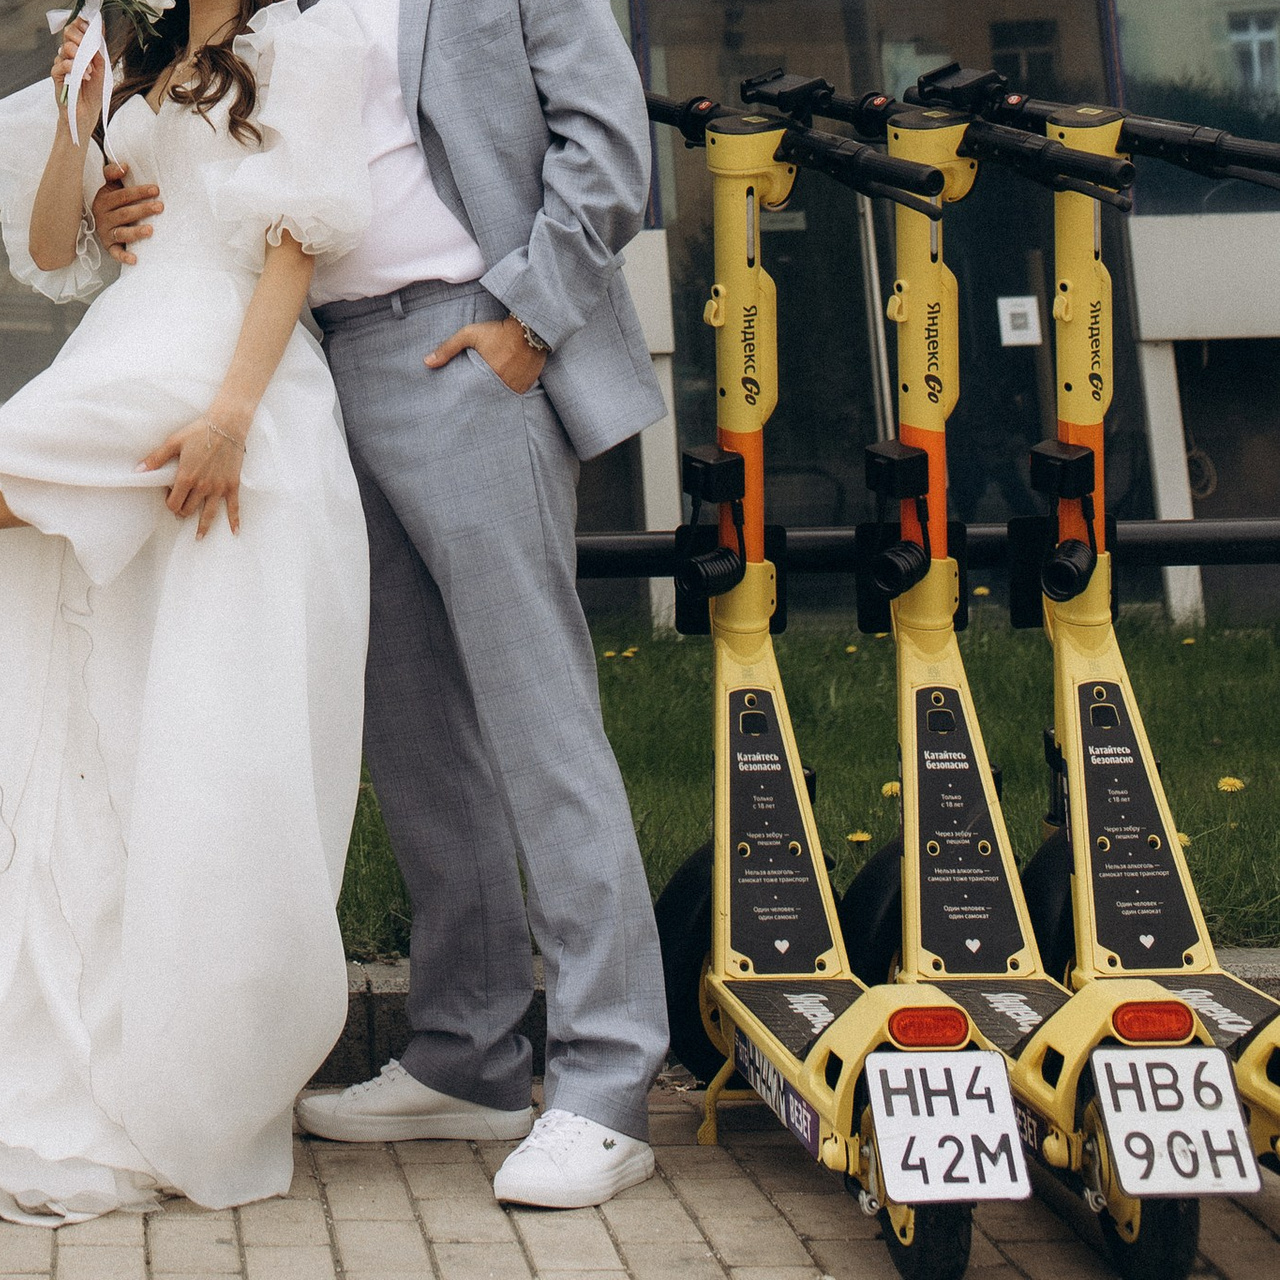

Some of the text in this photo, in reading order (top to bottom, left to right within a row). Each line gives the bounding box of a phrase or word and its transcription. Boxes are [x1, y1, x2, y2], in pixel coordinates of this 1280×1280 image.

[741, 305, 760, 406] Яндекс Go
[925, 302, 942, 403] Яндекс Go
[1088, 301, 1103, 401] Яндекс Go
[924, 750, 966, 760] Катайтесь
[1089, 745, 1130, 755] Катайтесь
[737, 752, 779, 761] Катайтесь
[1091, 756, 1134, 764] безопасно
[739, 762, 781, 771] безопасно
[926, 761, 969, 769] безопасно
[789, 1093, 811, 1142] ВЕЗЁТ
